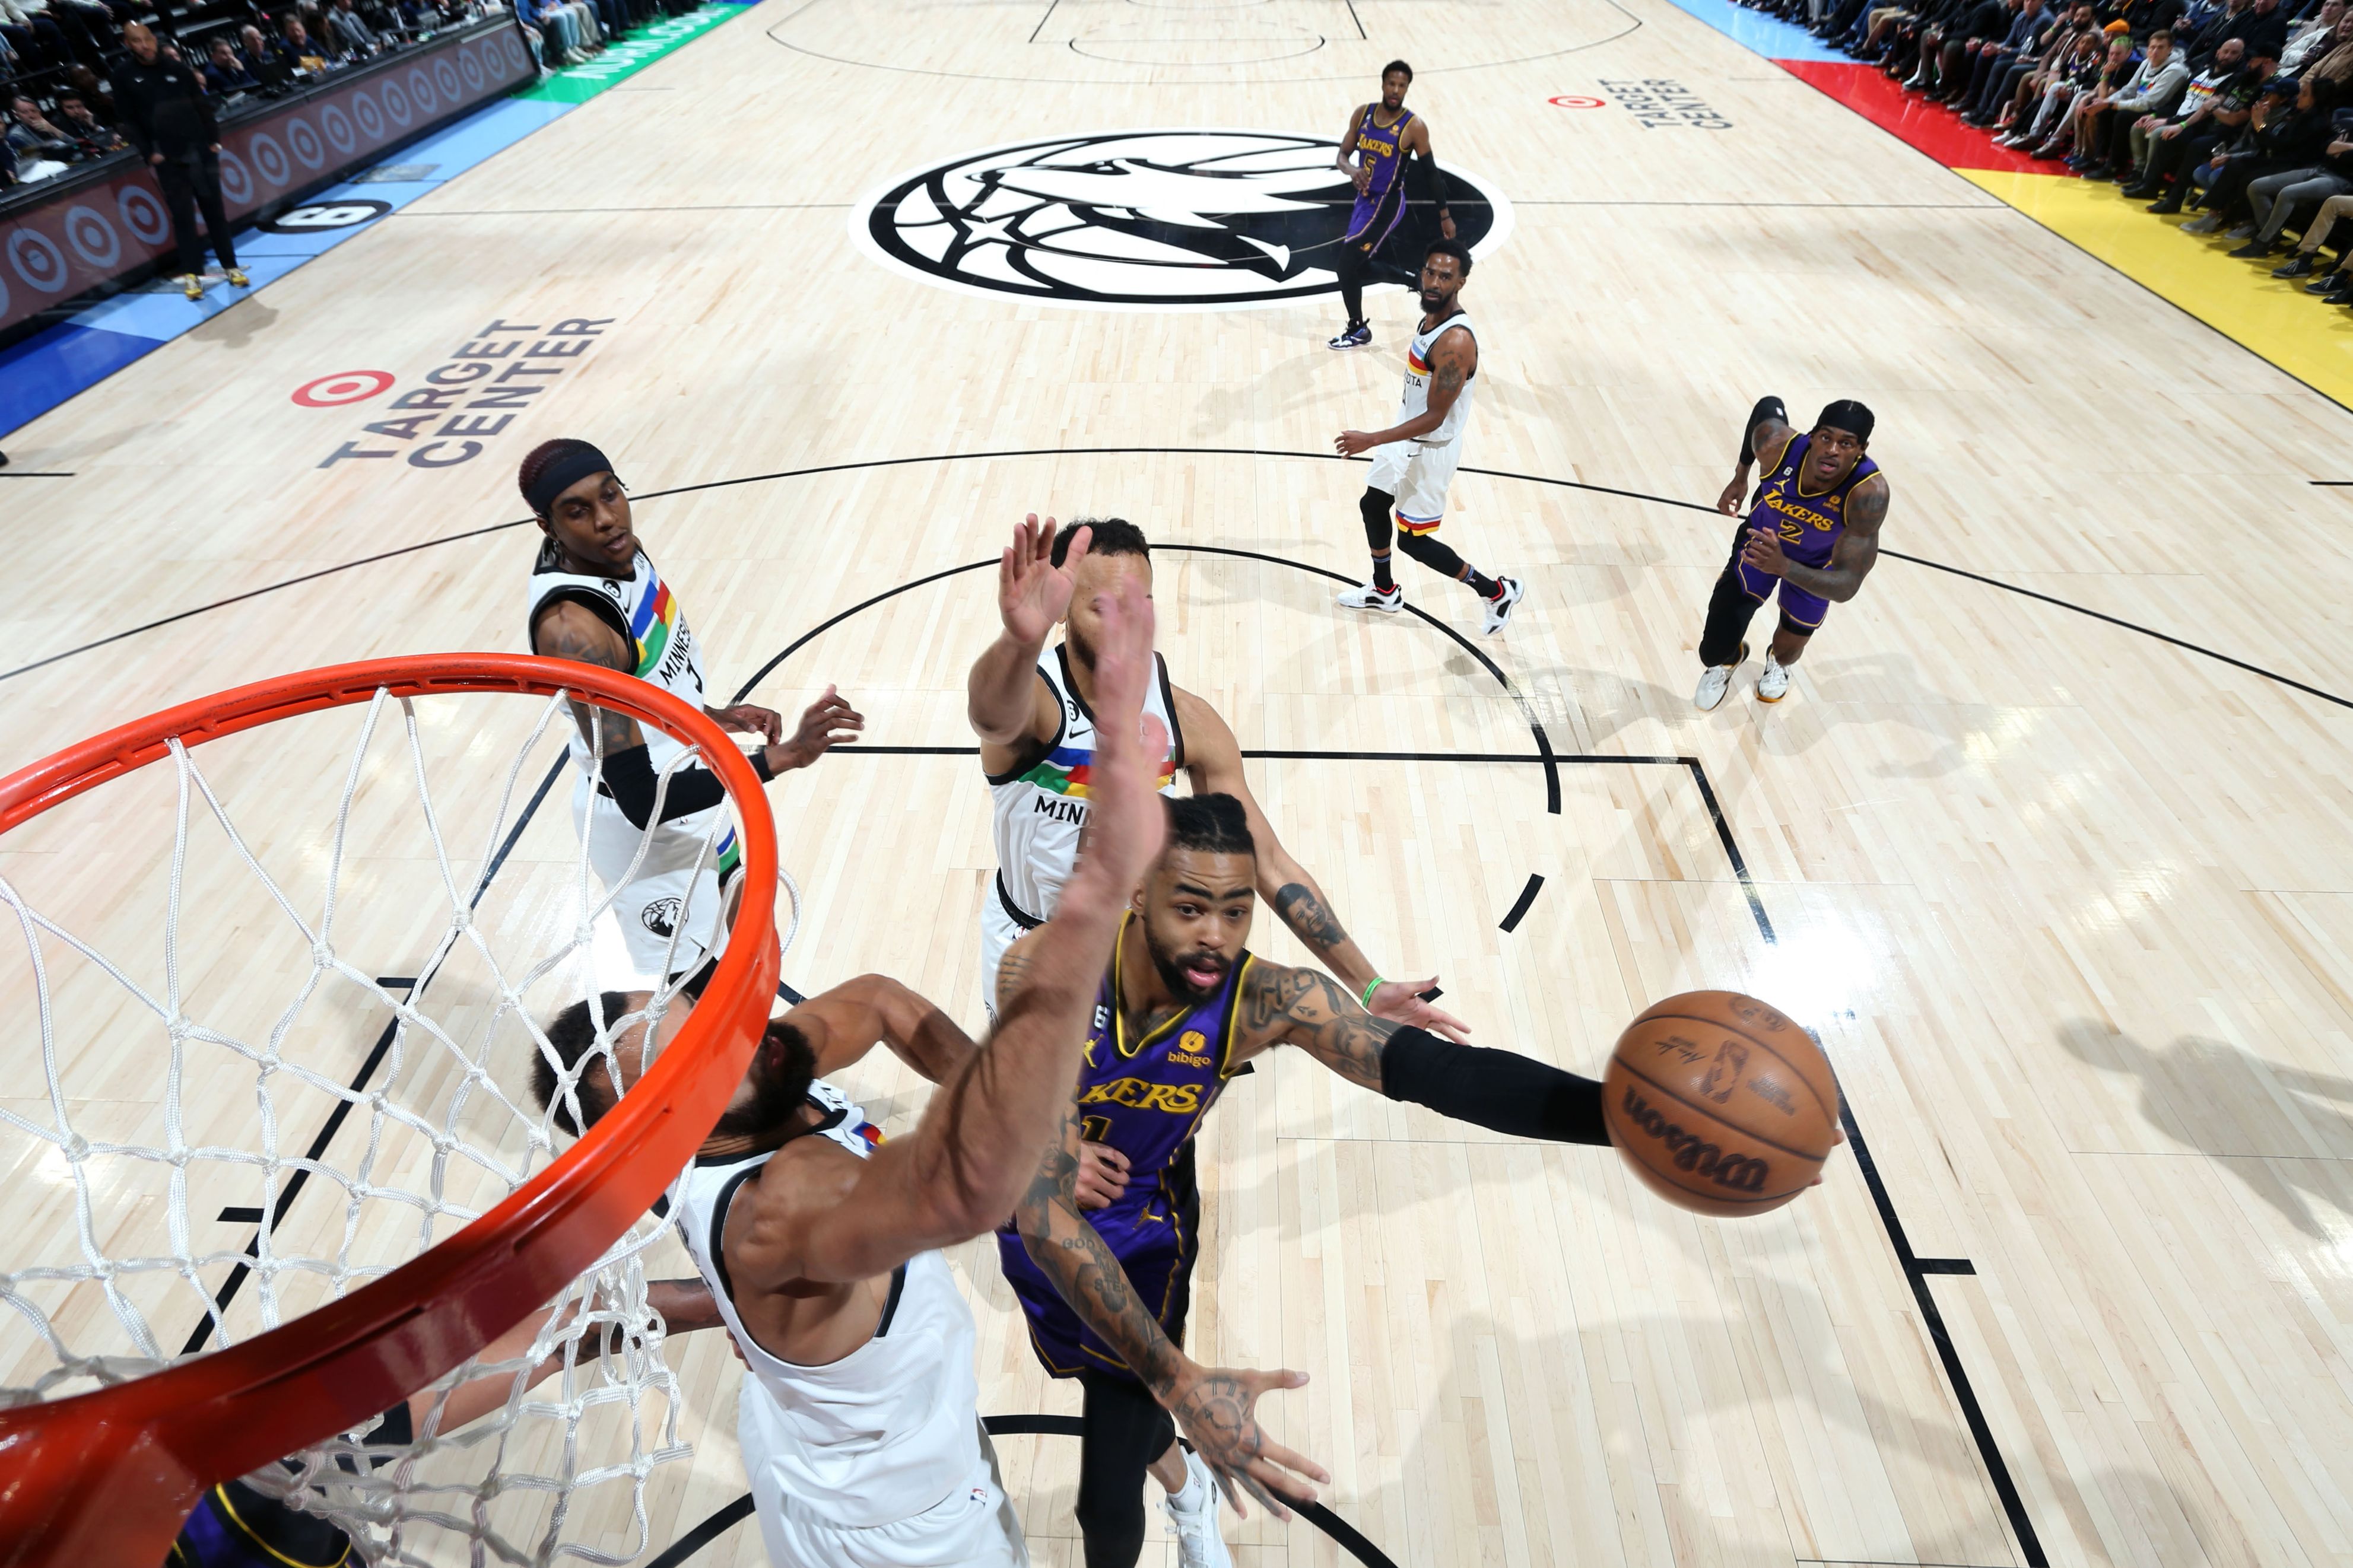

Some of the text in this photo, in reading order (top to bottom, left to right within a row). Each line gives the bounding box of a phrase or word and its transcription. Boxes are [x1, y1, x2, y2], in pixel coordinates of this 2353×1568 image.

[1598, 79, 1682, 128] TARGET
[1642, 79, 1733, 129] CENTER
[316, 320, 540, 468] TARGET
[408, 318, 617, 468] CENTER
[1783, 466, 1793, 476] 6
[1763, 488, 1834, 532] LAKERS
[1778, 519, 1804, 545] 2
[1167, 1051, 1211, 1068] bibigo
[1075, 1077, 1203, 1113] KERS
[1622, 1084, 1769, 1194] Wilson
